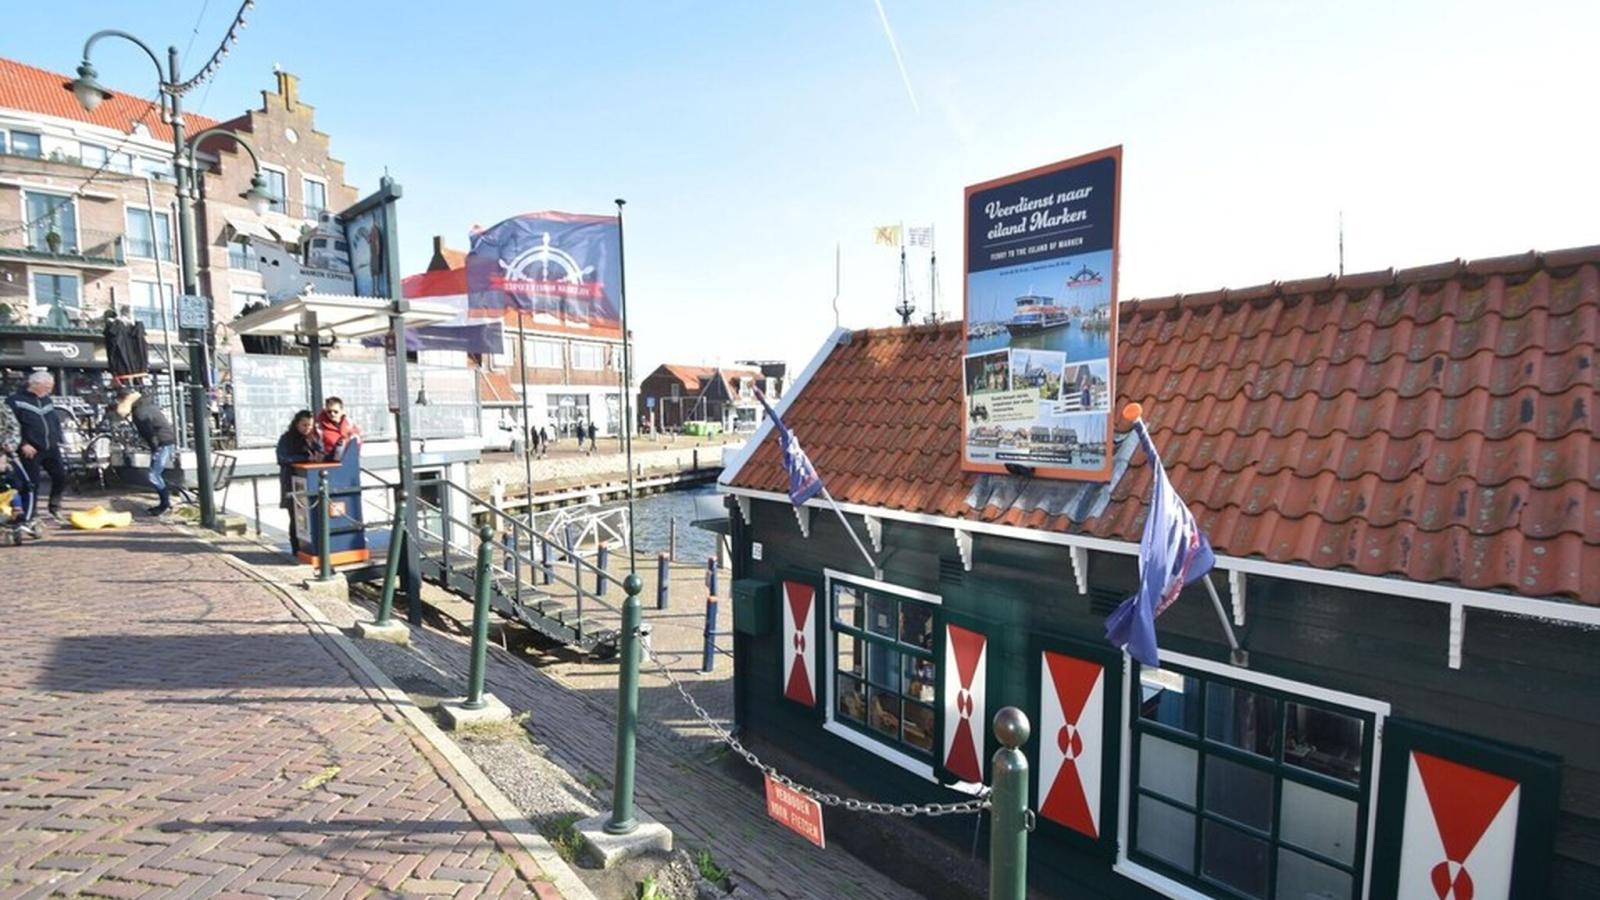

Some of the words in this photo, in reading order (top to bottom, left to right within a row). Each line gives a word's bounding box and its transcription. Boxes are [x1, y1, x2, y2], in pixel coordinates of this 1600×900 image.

[985, 194, 1054, 219] Veerdienst
[1056, 186, 1093, 203] naar
[987, 216, 1027, 240] eiland
[1029, 207, 1086, 231] Marken
[1008, 249, 1015, 257] TO
[1016, 247, 1026, 256] THE
[1028, 243, 1048, 254] ISLAND
[1049, 241, 1056, 250] OF
[1058, 236, 1084, 248] MARKEN
